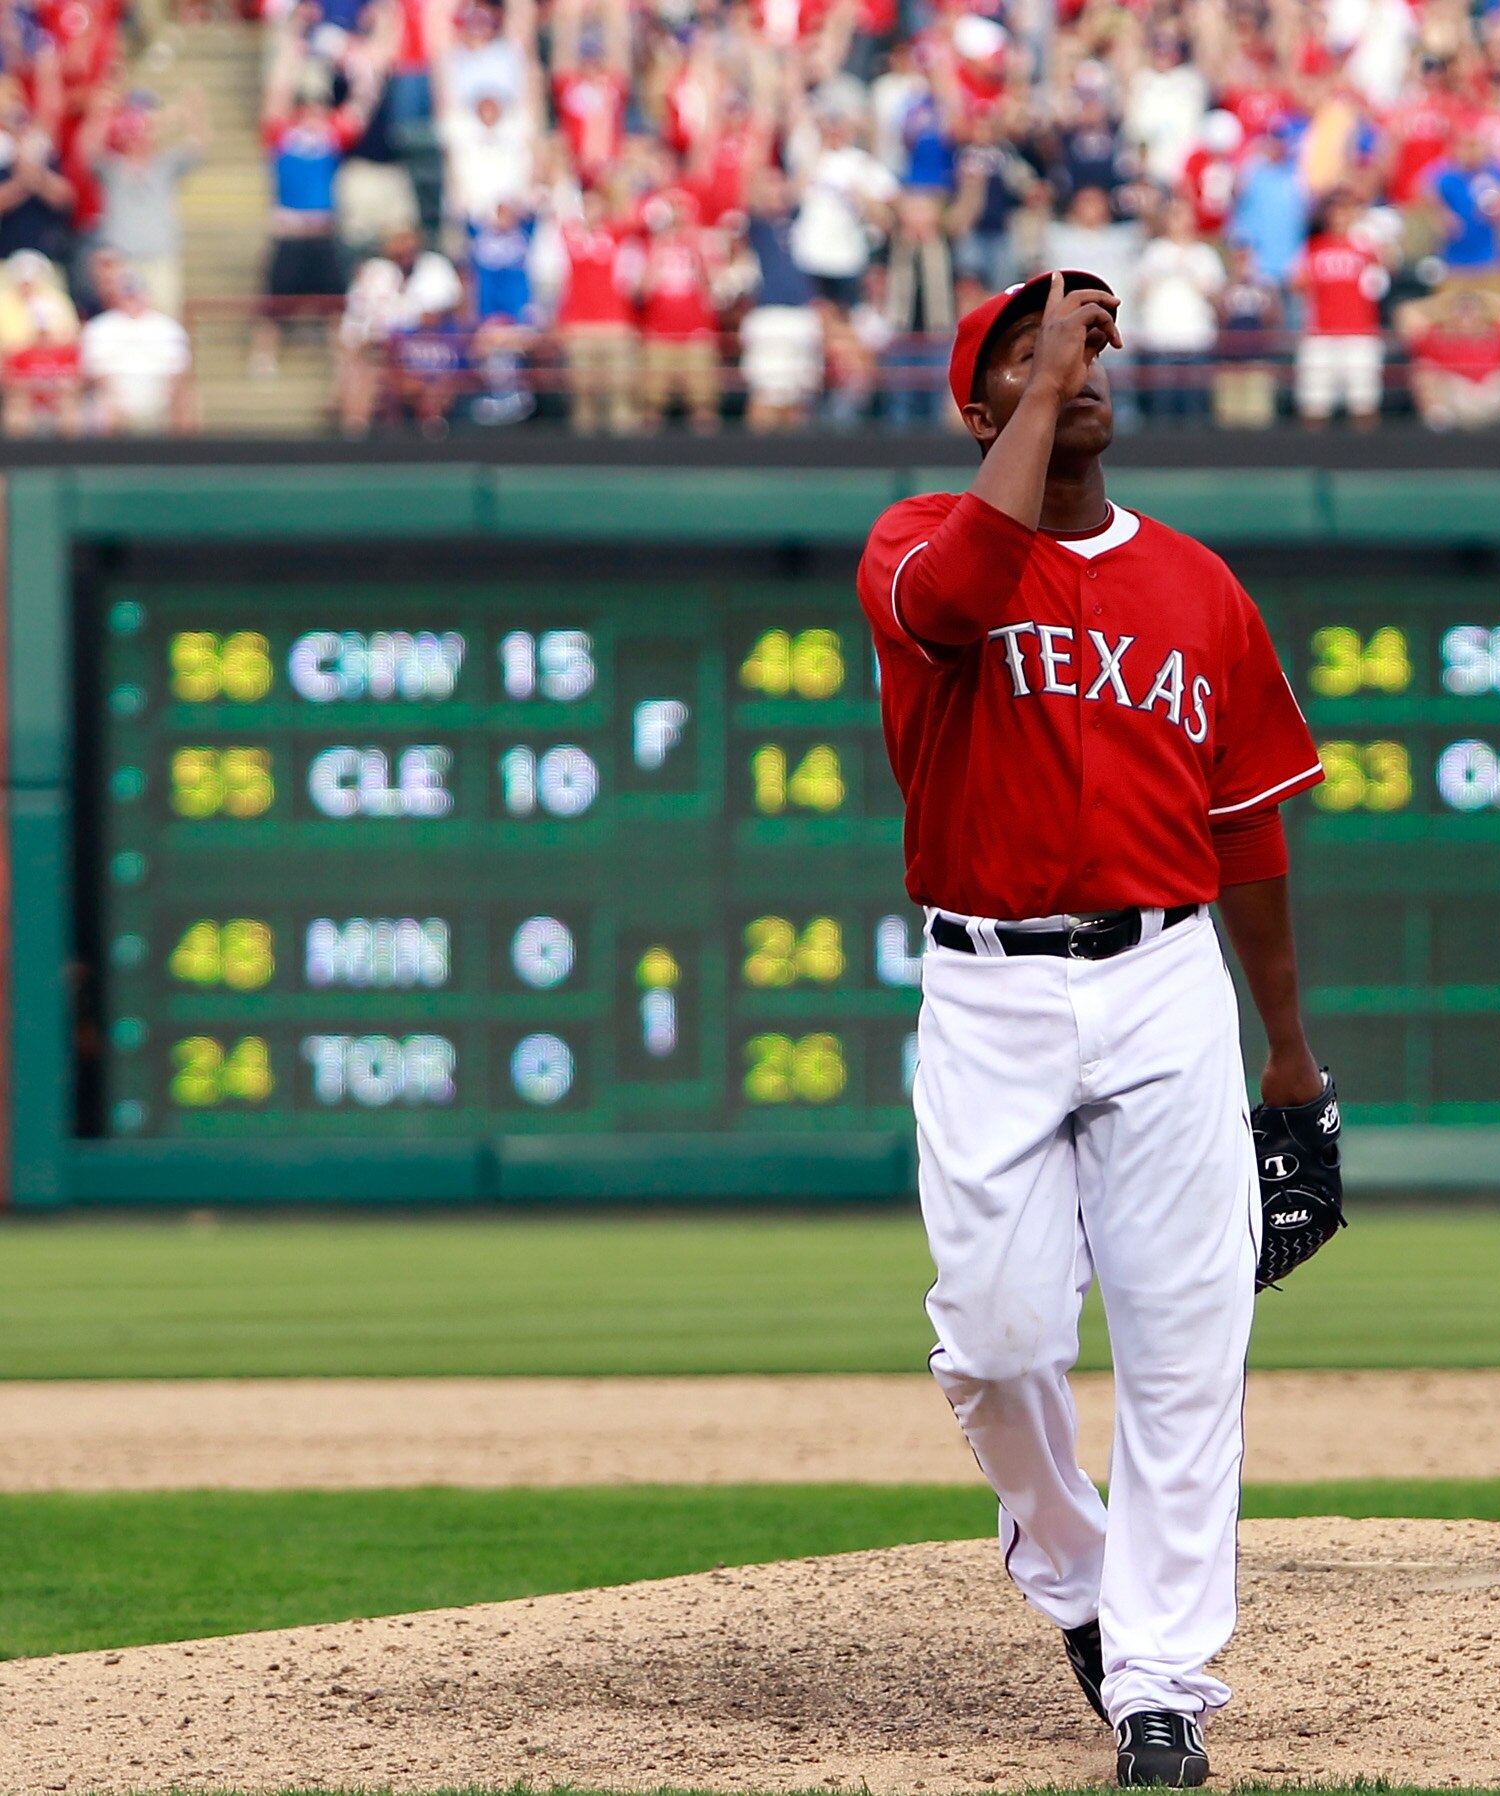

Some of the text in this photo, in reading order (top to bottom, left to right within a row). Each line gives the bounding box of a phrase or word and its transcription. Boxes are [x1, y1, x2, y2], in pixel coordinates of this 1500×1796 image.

[172, 630, 596, 703] 56 CHW 15
[741, 629, 846, 699] 46
[987, 620, 1211, 744] TEXAS
[1310, 626, 1412, 696] 34
[634, 699, 690, 769] F
[171, 744, 601, 818] 55 CLE 10
[752, 743, 845, 814] 14
[1315, 741, 1413, 810] 53
[172, 916, 575, 990] 48 MIN 0
[743, 916, 847, 987] 24
[641, 986, 677, 1056] 1
[171, 1033, 575, 1106] 24 TOR 0
[744, 1033, 847, 1102] 26
